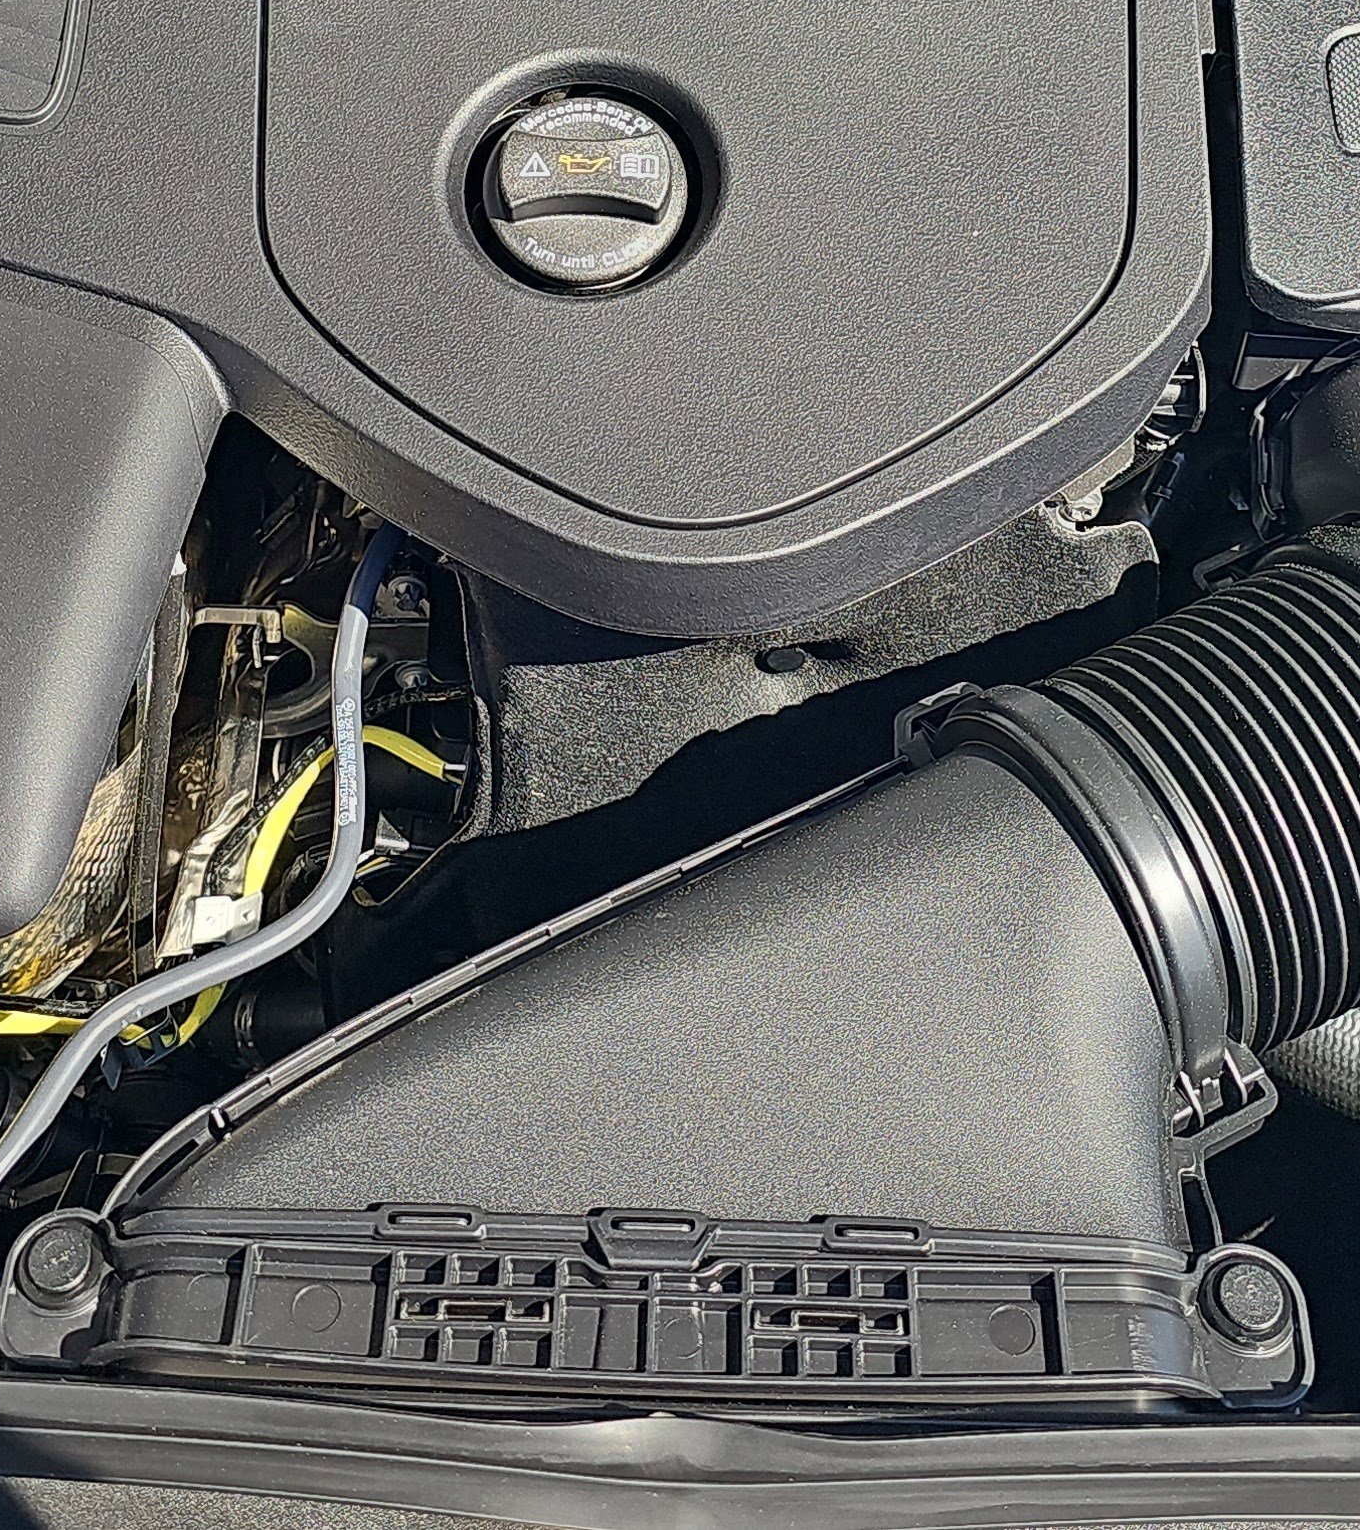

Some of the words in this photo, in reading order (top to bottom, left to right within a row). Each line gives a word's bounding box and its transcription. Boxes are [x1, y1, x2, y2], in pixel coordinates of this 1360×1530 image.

[520, 101, 633, 131] Mercedes-Benz
[634, 116, 654, 133] Oil
[539, 112, 636, 136] recommended
[525, 237, 556, 263] Turn
[561, 254, 595, 269] until
